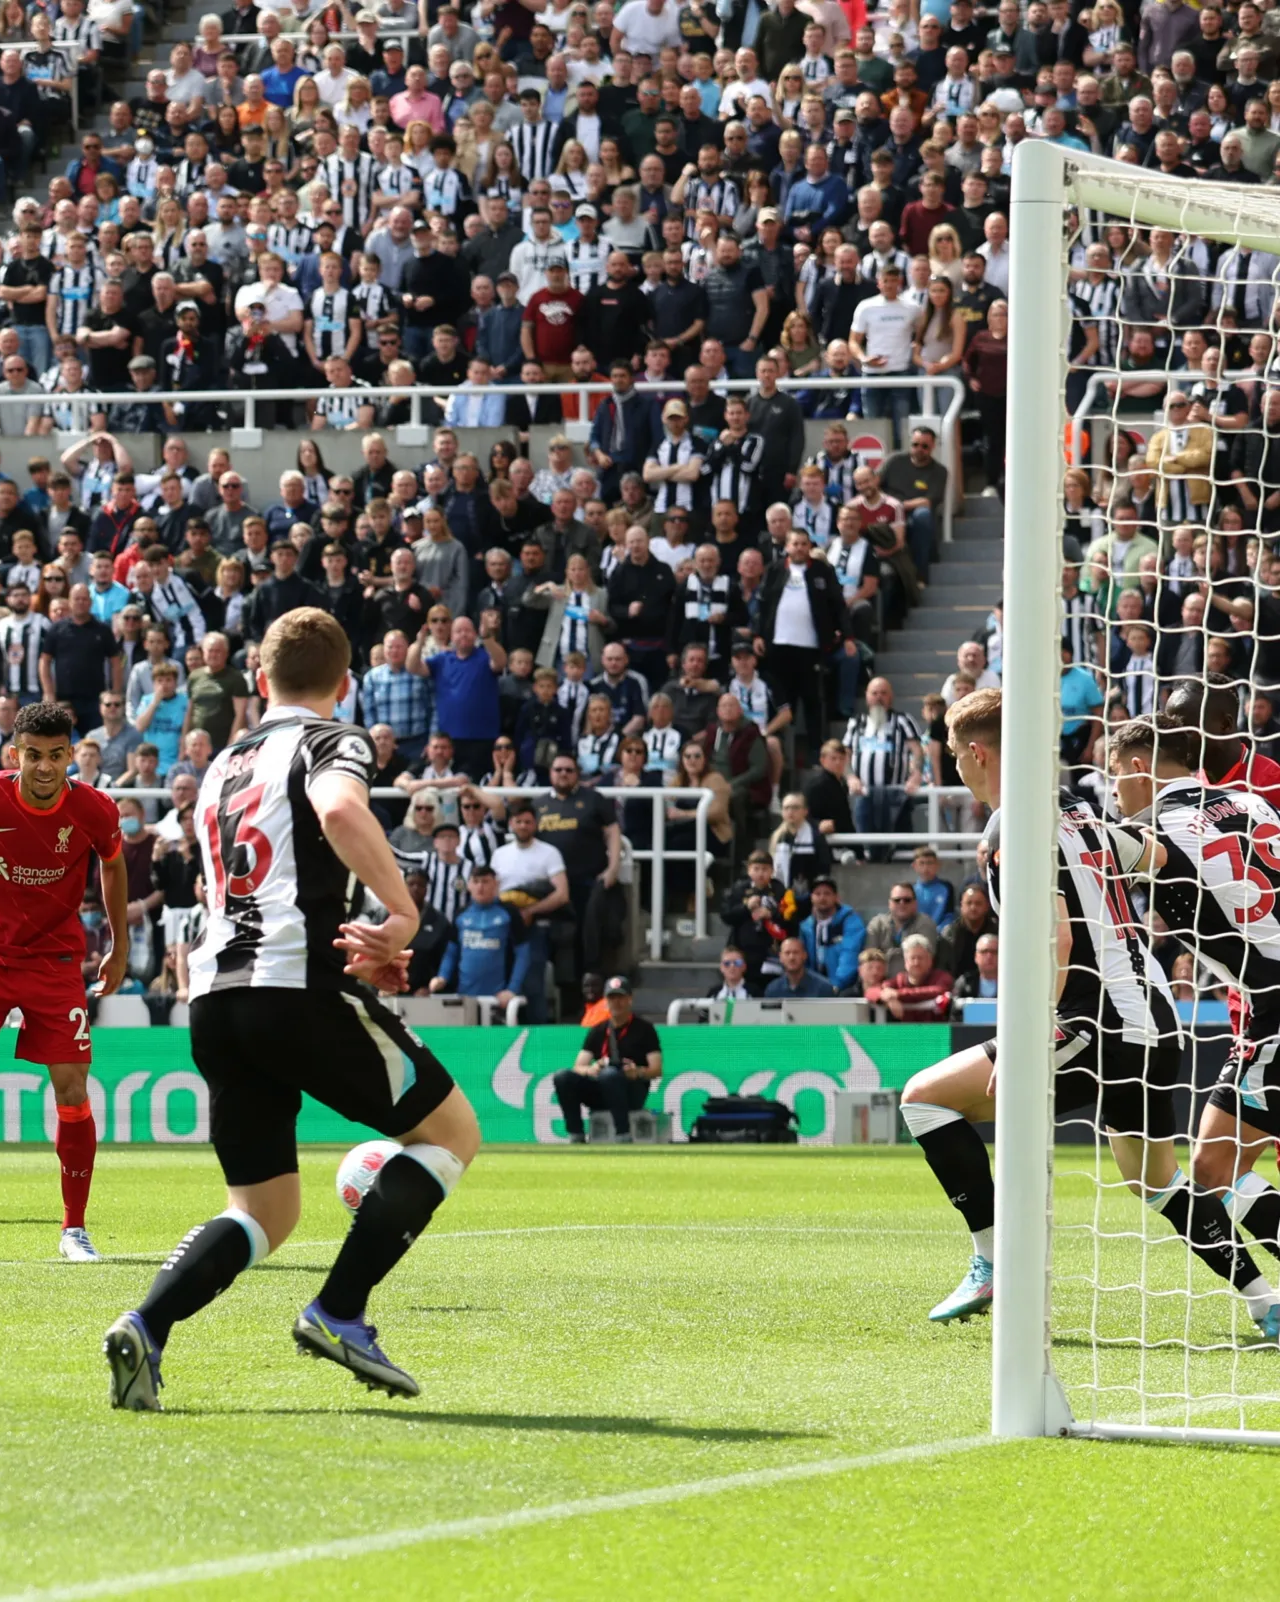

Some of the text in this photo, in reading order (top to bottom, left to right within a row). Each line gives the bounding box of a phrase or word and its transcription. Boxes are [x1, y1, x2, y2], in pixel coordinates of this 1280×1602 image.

[1186, 801, 1249, 837] BRUNO
[54, 844, 70, 854] LFC
[204, 782, 273, 910] 13
[12, 865, 66, 878] standard
[1079, 849, 1137, 940] 17
